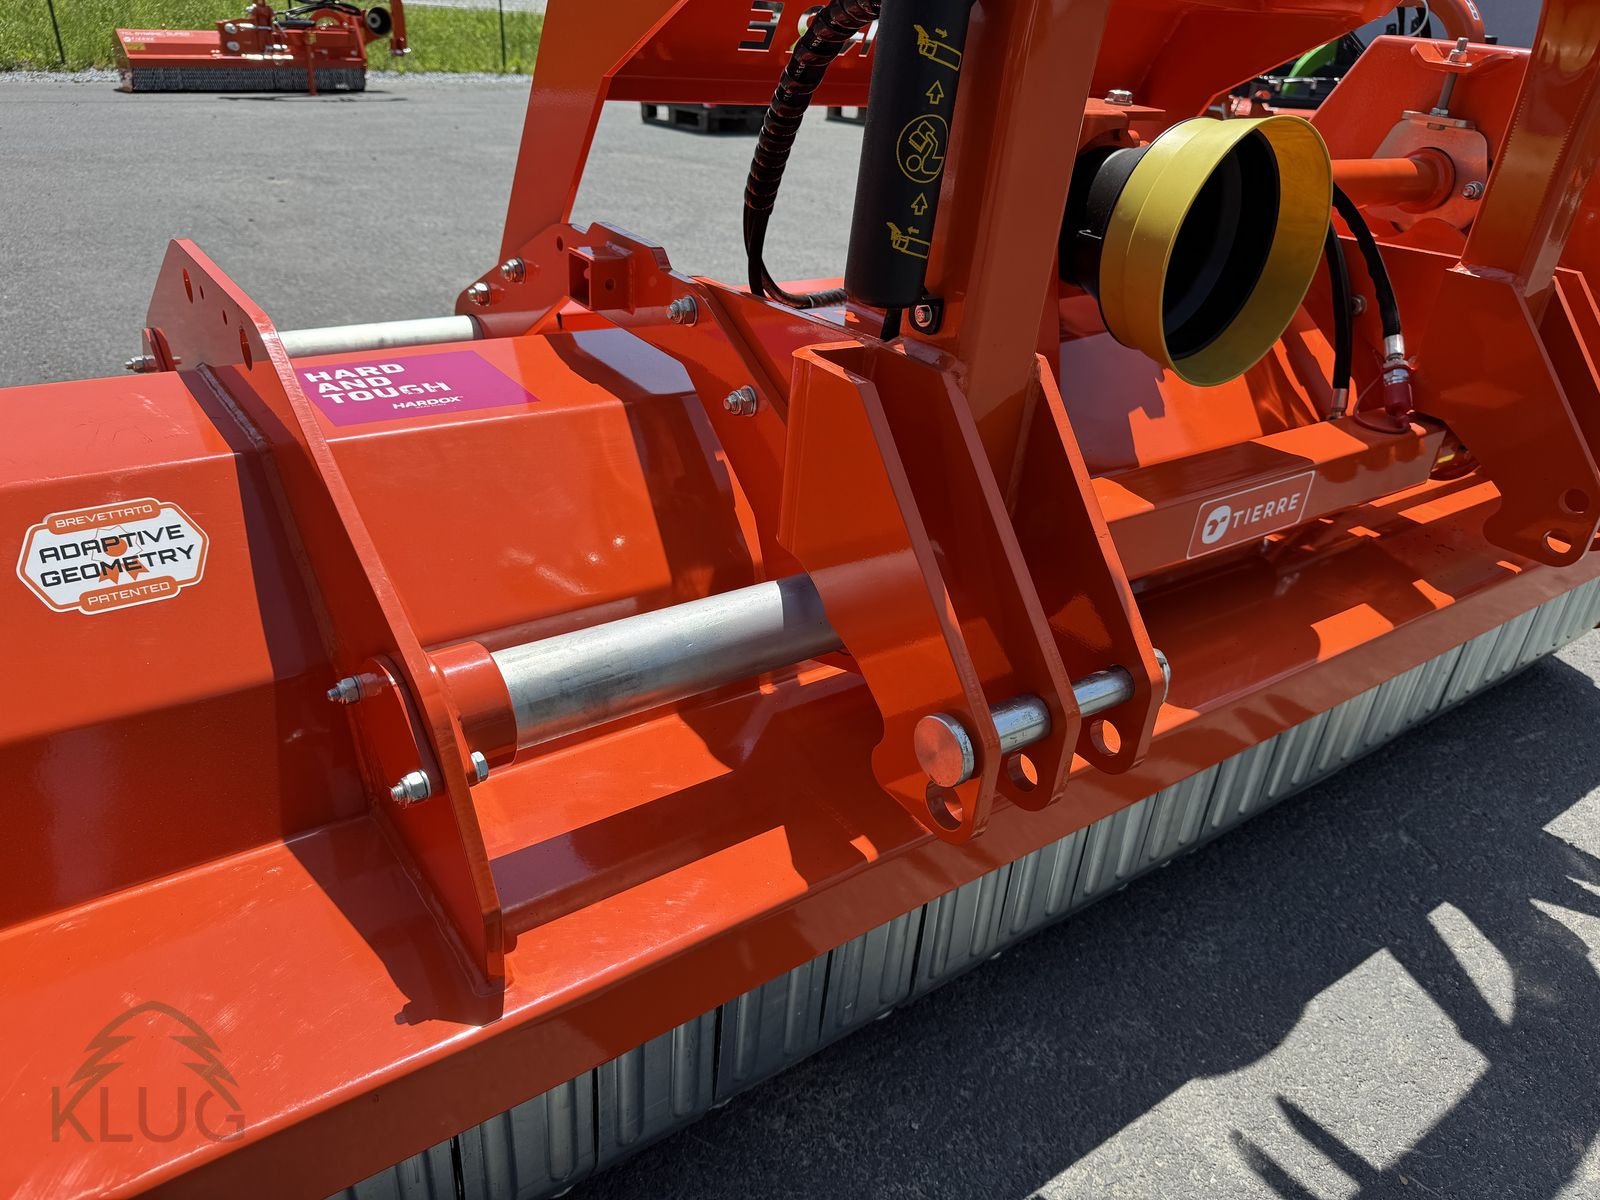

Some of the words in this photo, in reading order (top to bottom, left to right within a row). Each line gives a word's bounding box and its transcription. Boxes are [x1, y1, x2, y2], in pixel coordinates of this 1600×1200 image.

[304, 363, 405, 383] HARD
[318, 376, 392, 394] AND
[323, 380, 452, 404] TOUGH
[392, 396, 460, 410] HARDOX
[55, 504, 153, 528] BREVETTATO
[1232, 492, 1301, 529] TIERRE
[39, 524, 185, 564] ADAPTIVE
[40, 544, 195, 587] GEOMETRY
[87, 581, 171, 606] PATENTED
